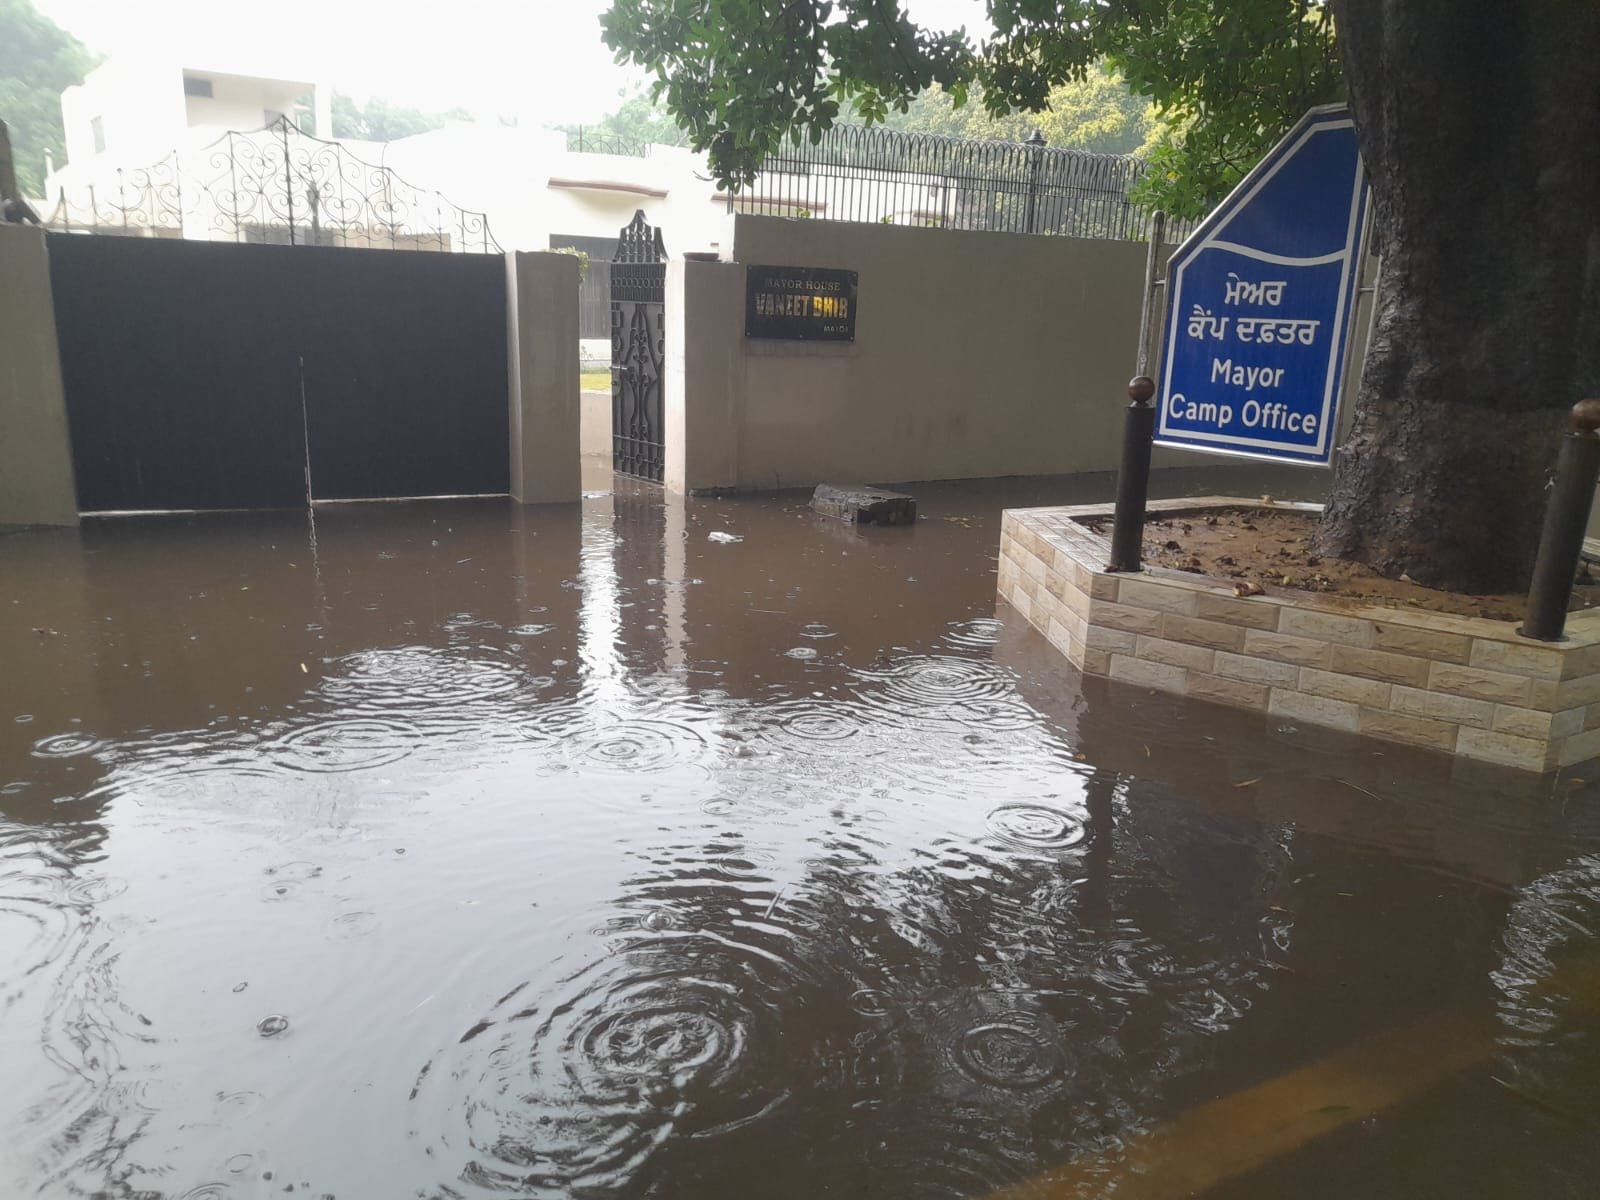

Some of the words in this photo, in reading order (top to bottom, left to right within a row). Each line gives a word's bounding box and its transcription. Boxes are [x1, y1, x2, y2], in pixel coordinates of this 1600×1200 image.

[806, 280, 841, 290] HOUSE
[812, 295, 848, 319] DHIR
[1188, 304, 1229, 340] ਕੈਂਪ
[1210, 357, 1285, 391] Mayor
[1169, 393, 1233, 428] Camp
[1241, 400, 1317, 434] Office
